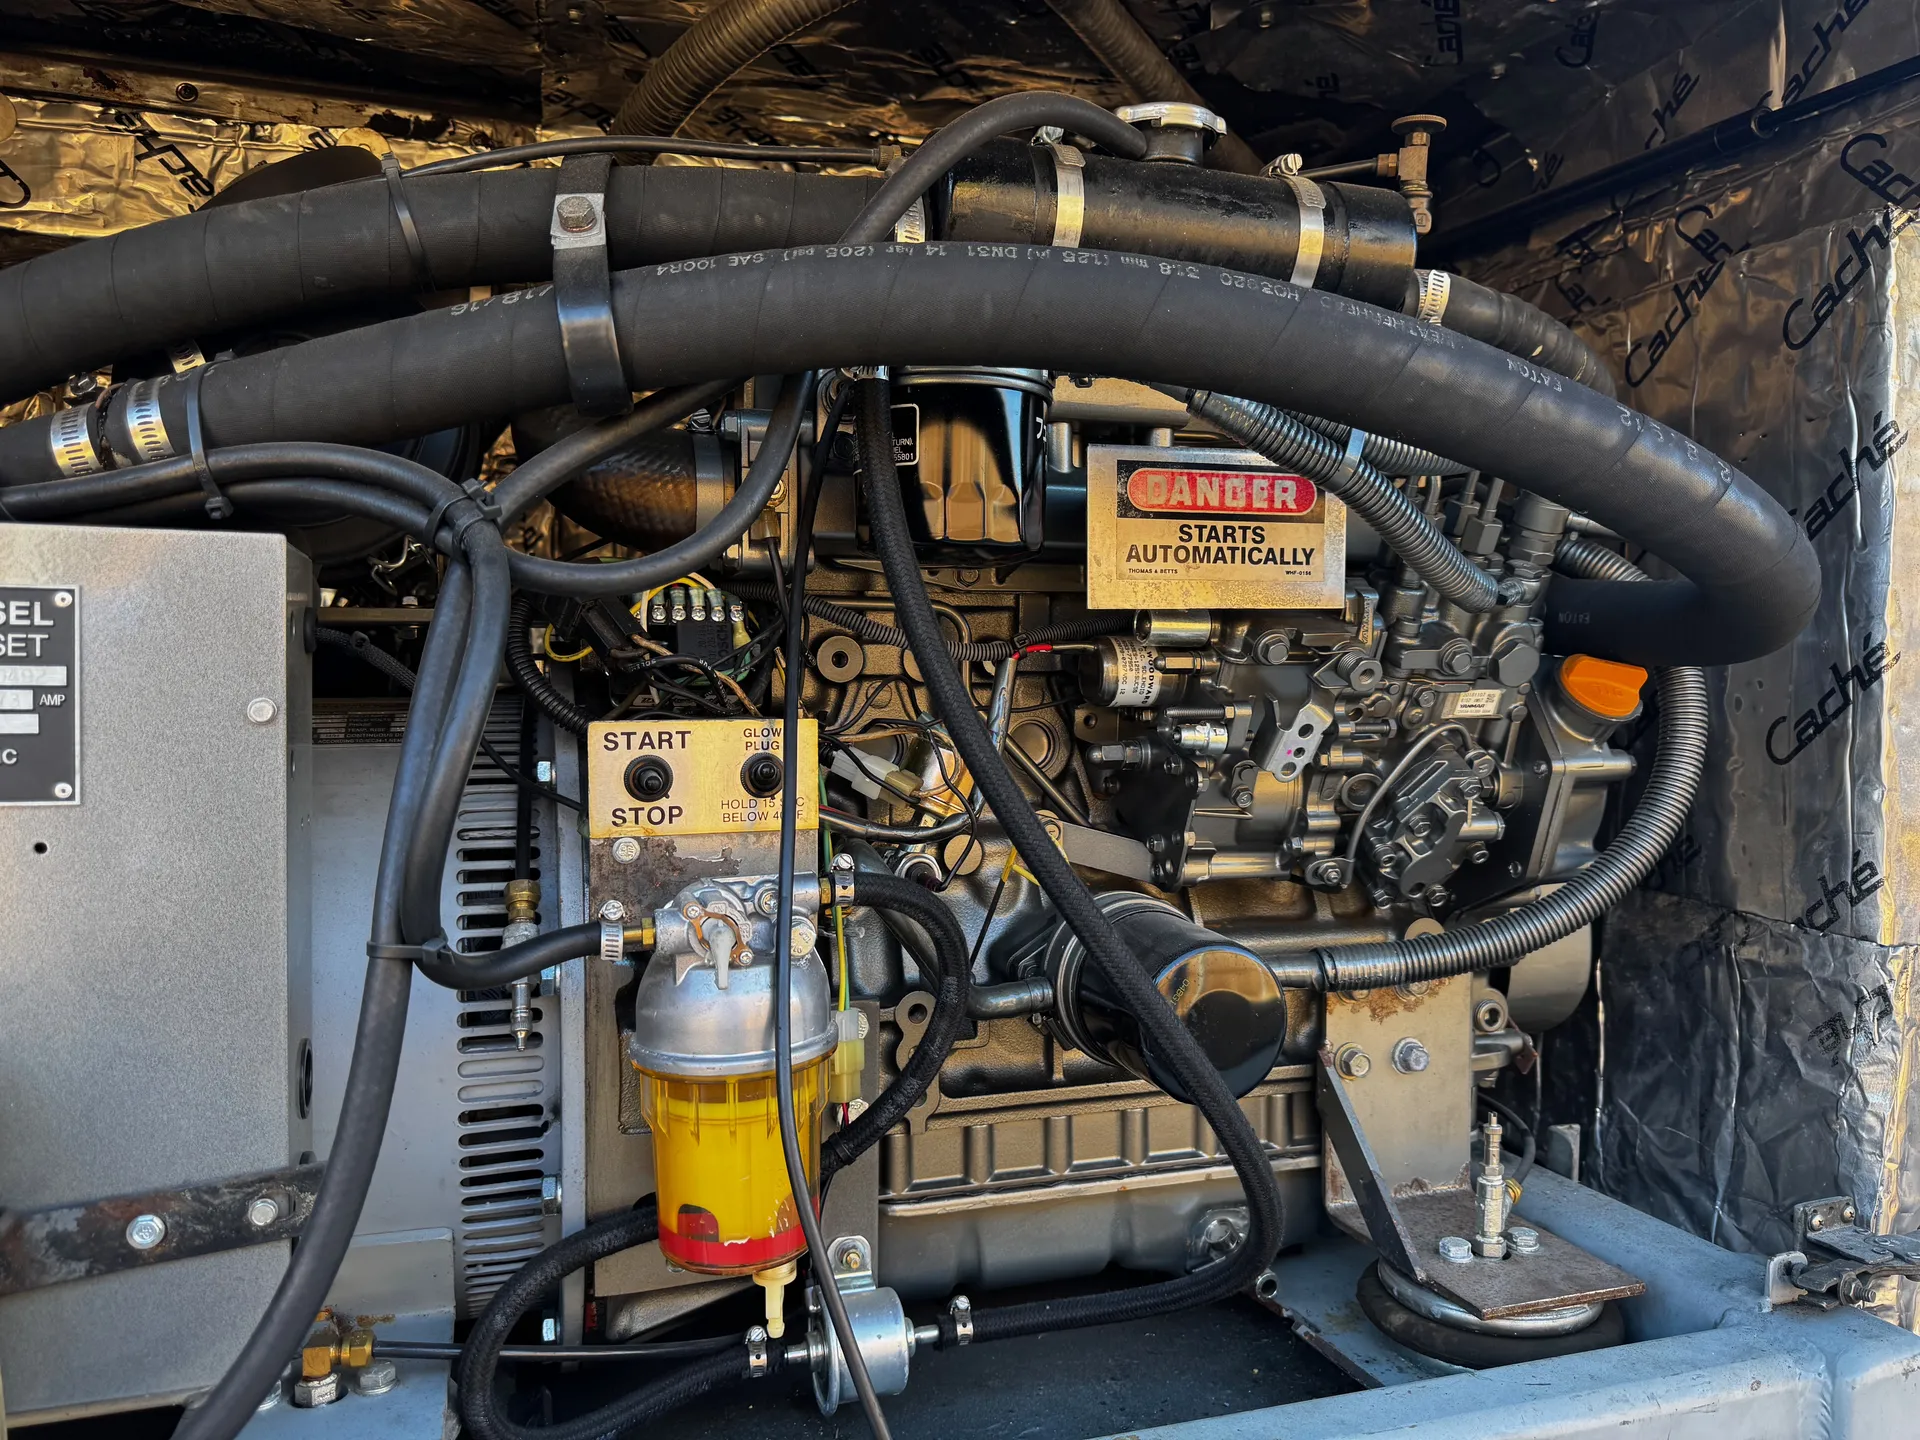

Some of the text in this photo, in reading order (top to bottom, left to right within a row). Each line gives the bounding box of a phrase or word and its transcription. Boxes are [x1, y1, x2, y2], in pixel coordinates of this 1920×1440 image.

[728, 253, 766, 268] SAE
[967, 245, 1018, 260] DN31
[656, 257, 717, 277] 100R4
[1119, 255, 1149, 269] mm
[1146, 473, 1298, 511] DANGER
[1178, 524, 1265, 545] STARTS
[1126, 544, 1315, 567] AUTOMATICALLY
[1141, 651, 1155, 705] WOODWARD
[39, 694, 66, 707] AMP
[1766, 631, 1902, 767] Caché
[603, 730, 692, 751] START
[743, 727, 782, 738] GLOW
[745, 740, 780, 751] PLUG
[721, 798, 758, 810] HOLD
[762, 798, 776, 808] 15
[611, 805, 683, 827] STOP
[722, 811, 769, 823] BELOW
